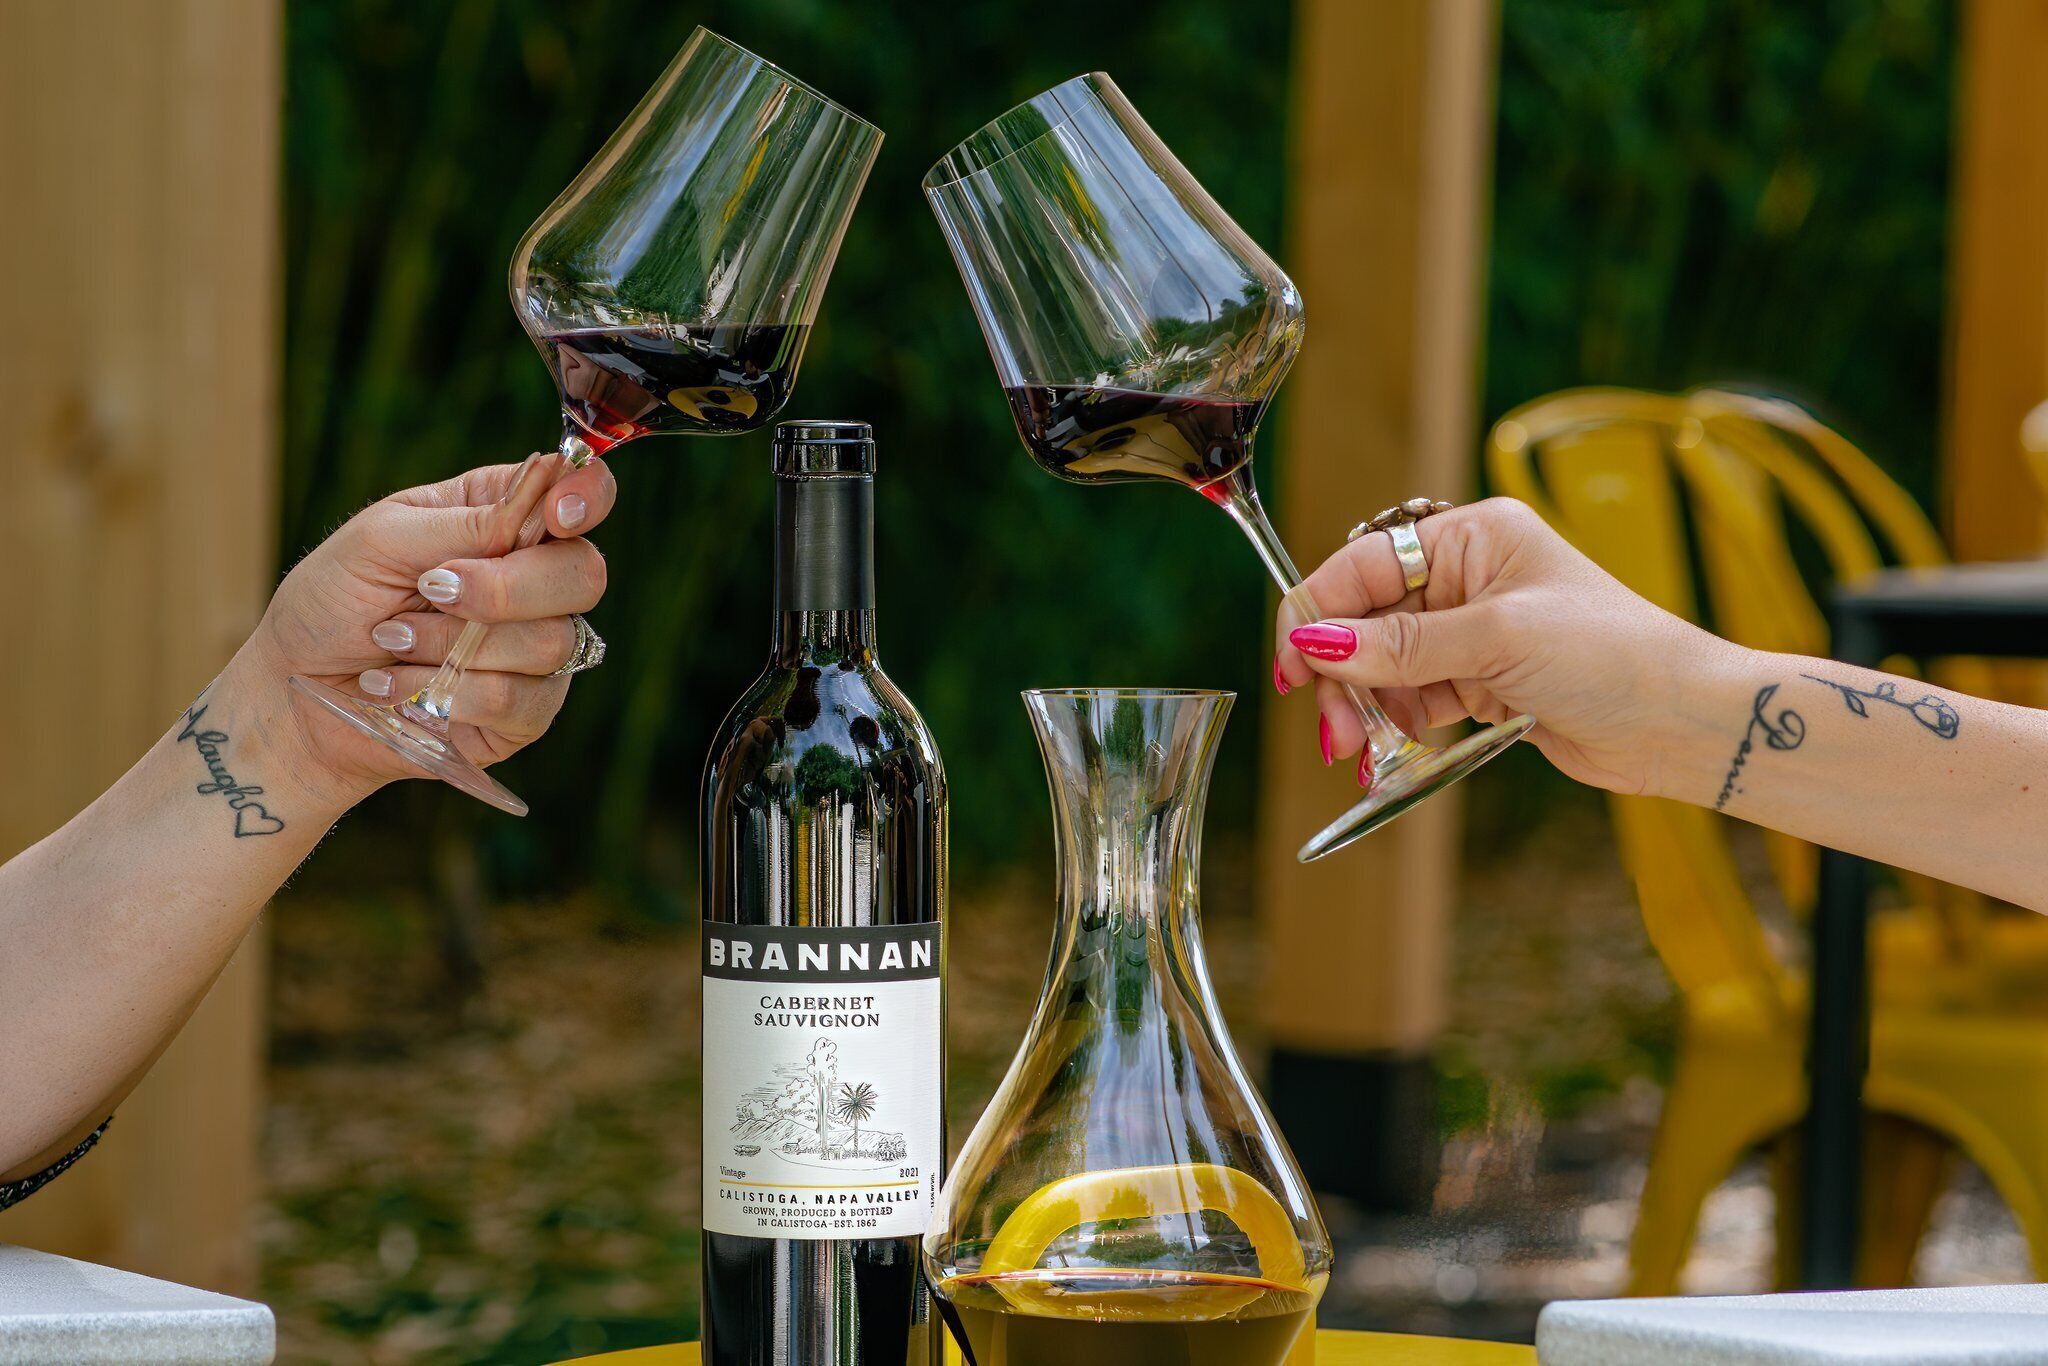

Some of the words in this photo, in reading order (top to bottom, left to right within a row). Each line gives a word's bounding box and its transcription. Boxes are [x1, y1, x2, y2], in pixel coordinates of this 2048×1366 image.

[196, 730, 264, 810] laugh
[710, 938, 931, 971] BRANNAN
[759, 995, 875, 1010] CABERNET
[753, 1012, 880, 1028] SAUVIGNON
[719, 1165, 746, 1179] Vintage
[899, 1167, 919, 1178] 2021
[719, 1188, 805, 1205] CALISTOGA,
[815, 1194, 858, 1204] NAPA
[866, 1189, 919, 1204] VALLEY
[742, 1206, 778, 1217] GROWN,
[781, 1208, 836, 1217] PRODUCED
[839, 1208, 847, 1217] &
[850, 1206, 893, 1216] BOTTLED
[757, 1218, 767, 1226] IN
[857, 1218, 877, 1227] 1862
